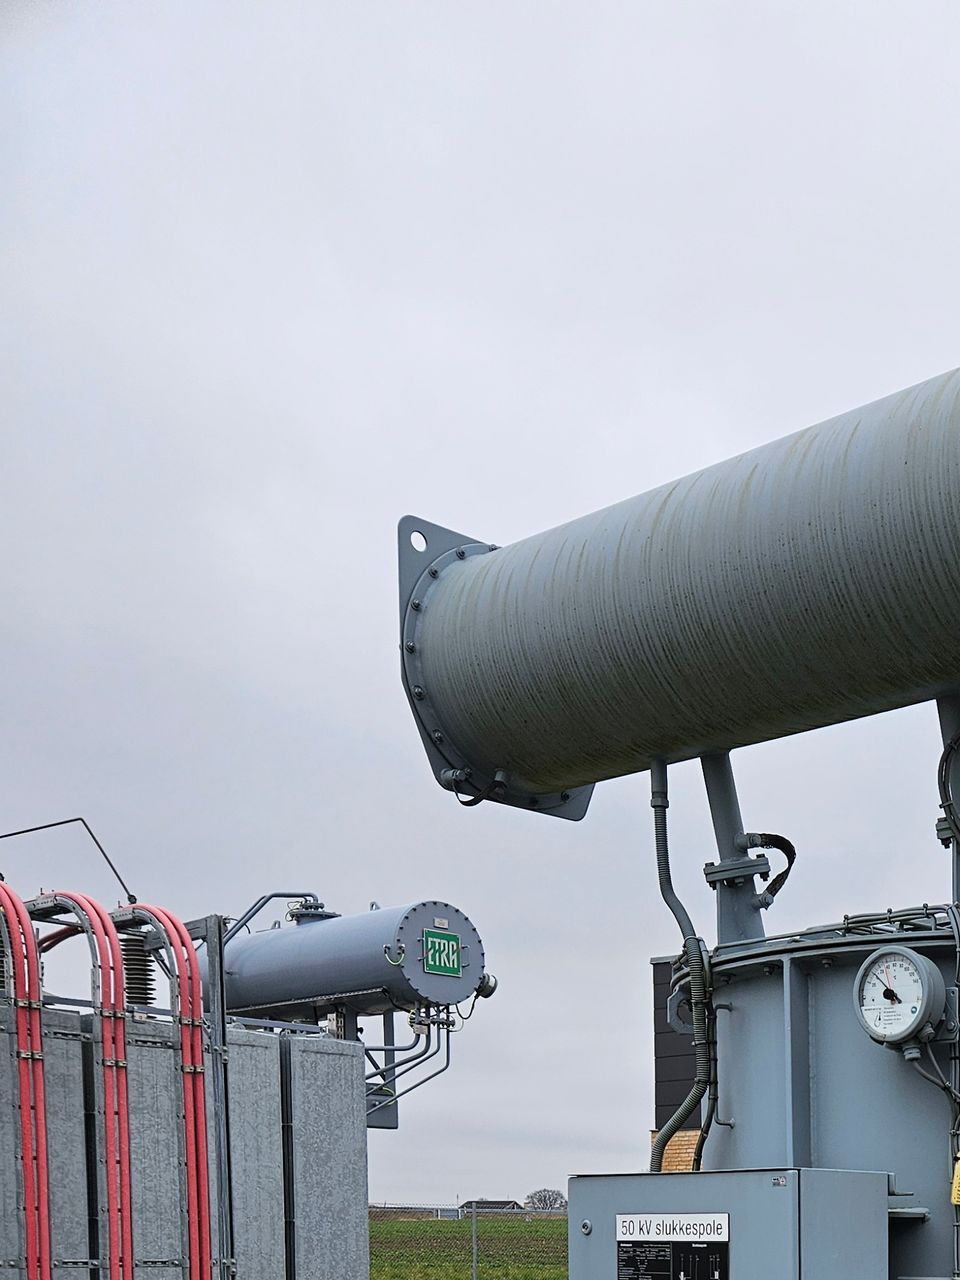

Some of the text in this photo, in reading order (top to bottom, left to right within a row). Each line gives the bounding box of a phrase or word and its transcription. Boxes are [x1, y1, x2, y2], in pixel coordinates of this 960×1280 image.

[428, 937, 457, 968] ETRA
[621, 1220, 723, 1238] 50 kV slukkespole
